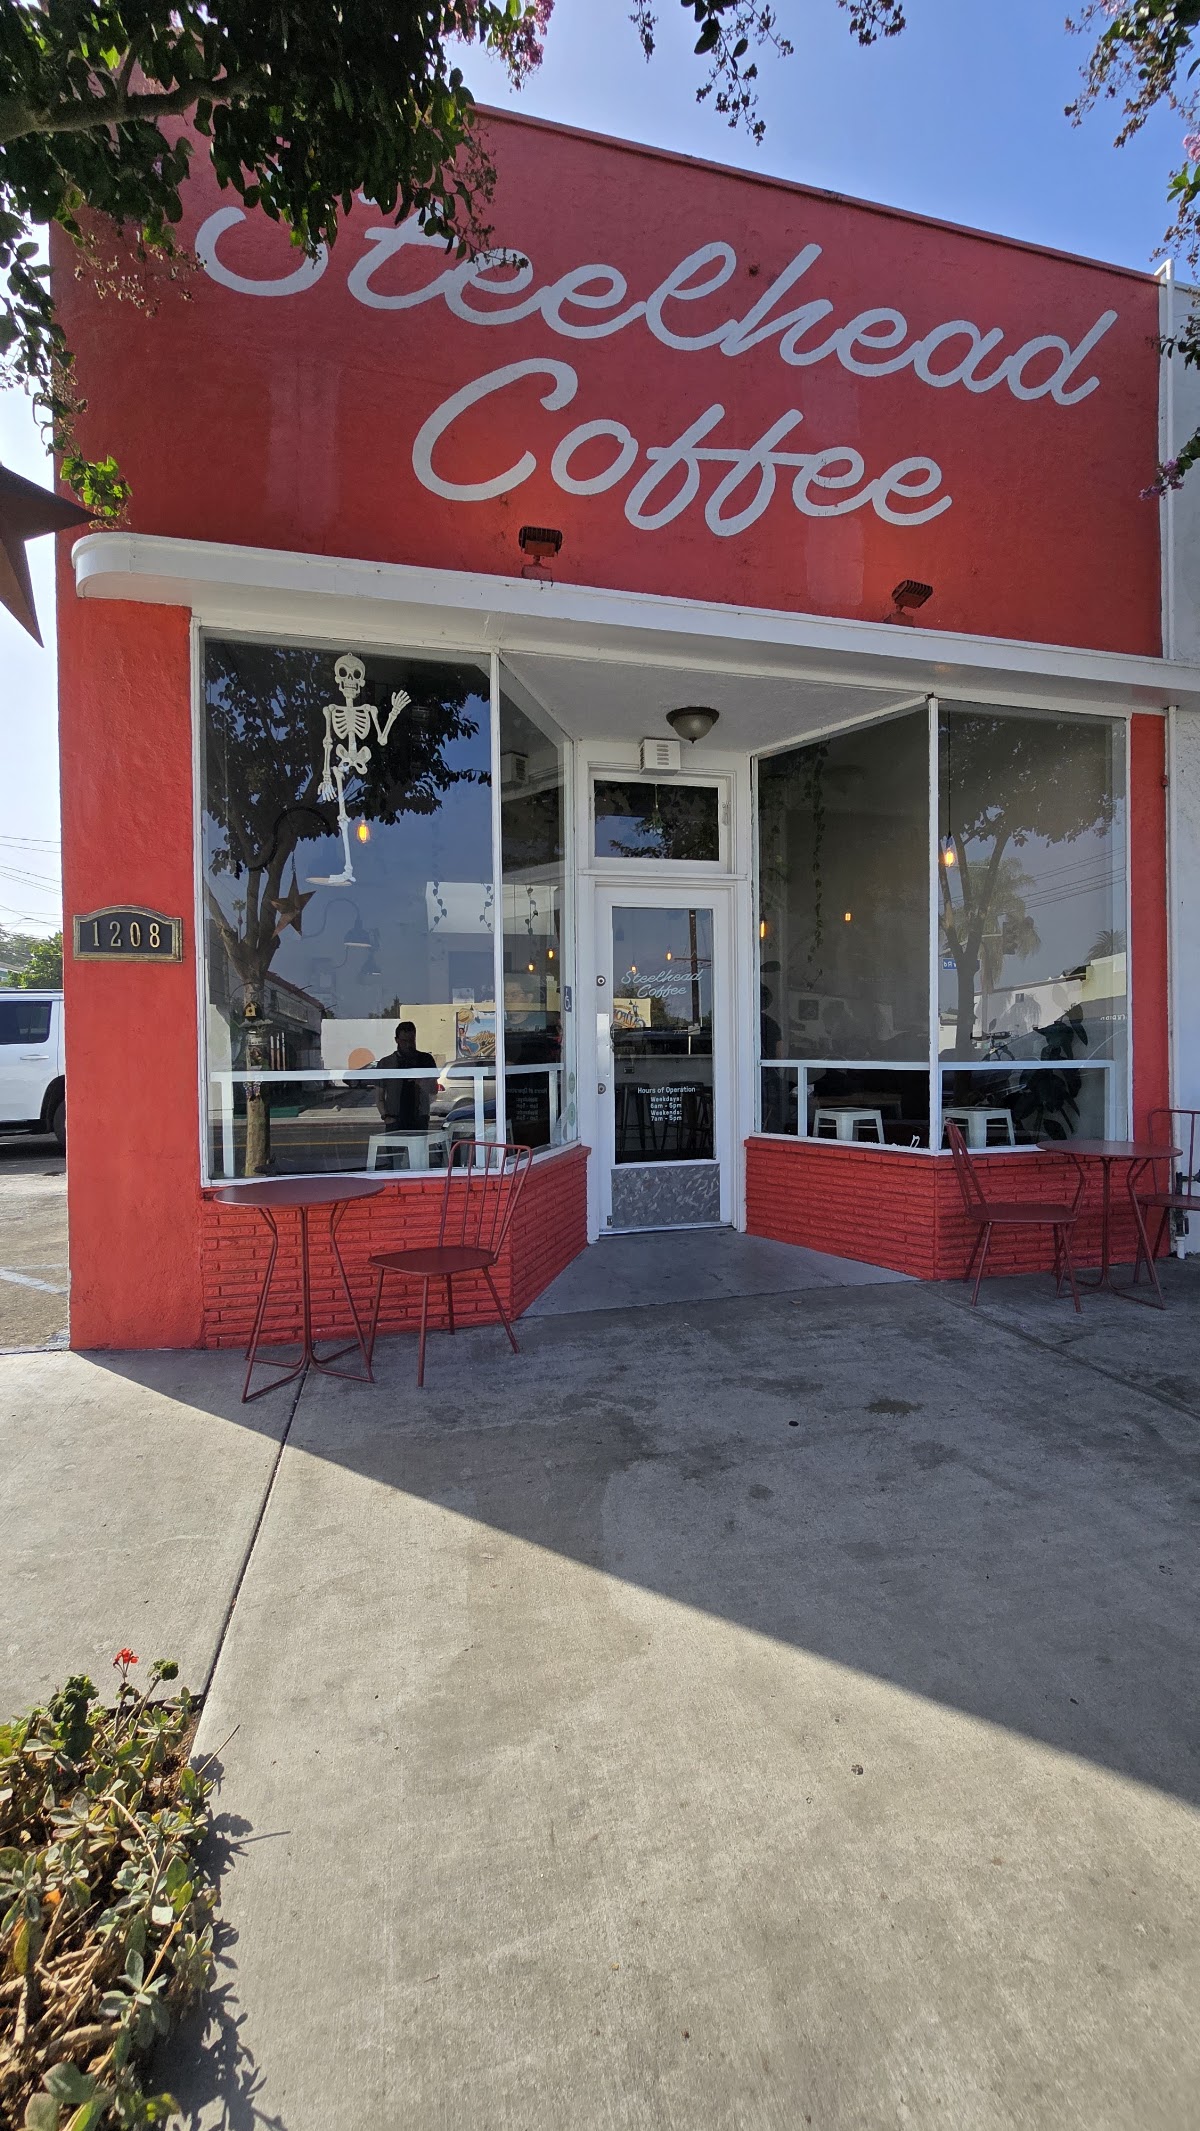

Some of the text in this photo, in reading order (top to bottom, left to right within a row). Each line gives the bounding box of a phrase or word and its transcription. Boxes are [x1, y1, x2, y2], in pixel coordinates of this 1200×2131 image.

[411, 357, 953, 538] Coffee
[92, 920, 161, 949] 1208
[620, 969, 704, 985] Steelhead
[636, 984, 687, 999] Coffee
[637, 1085, 696, 1095] Hours of Operation
